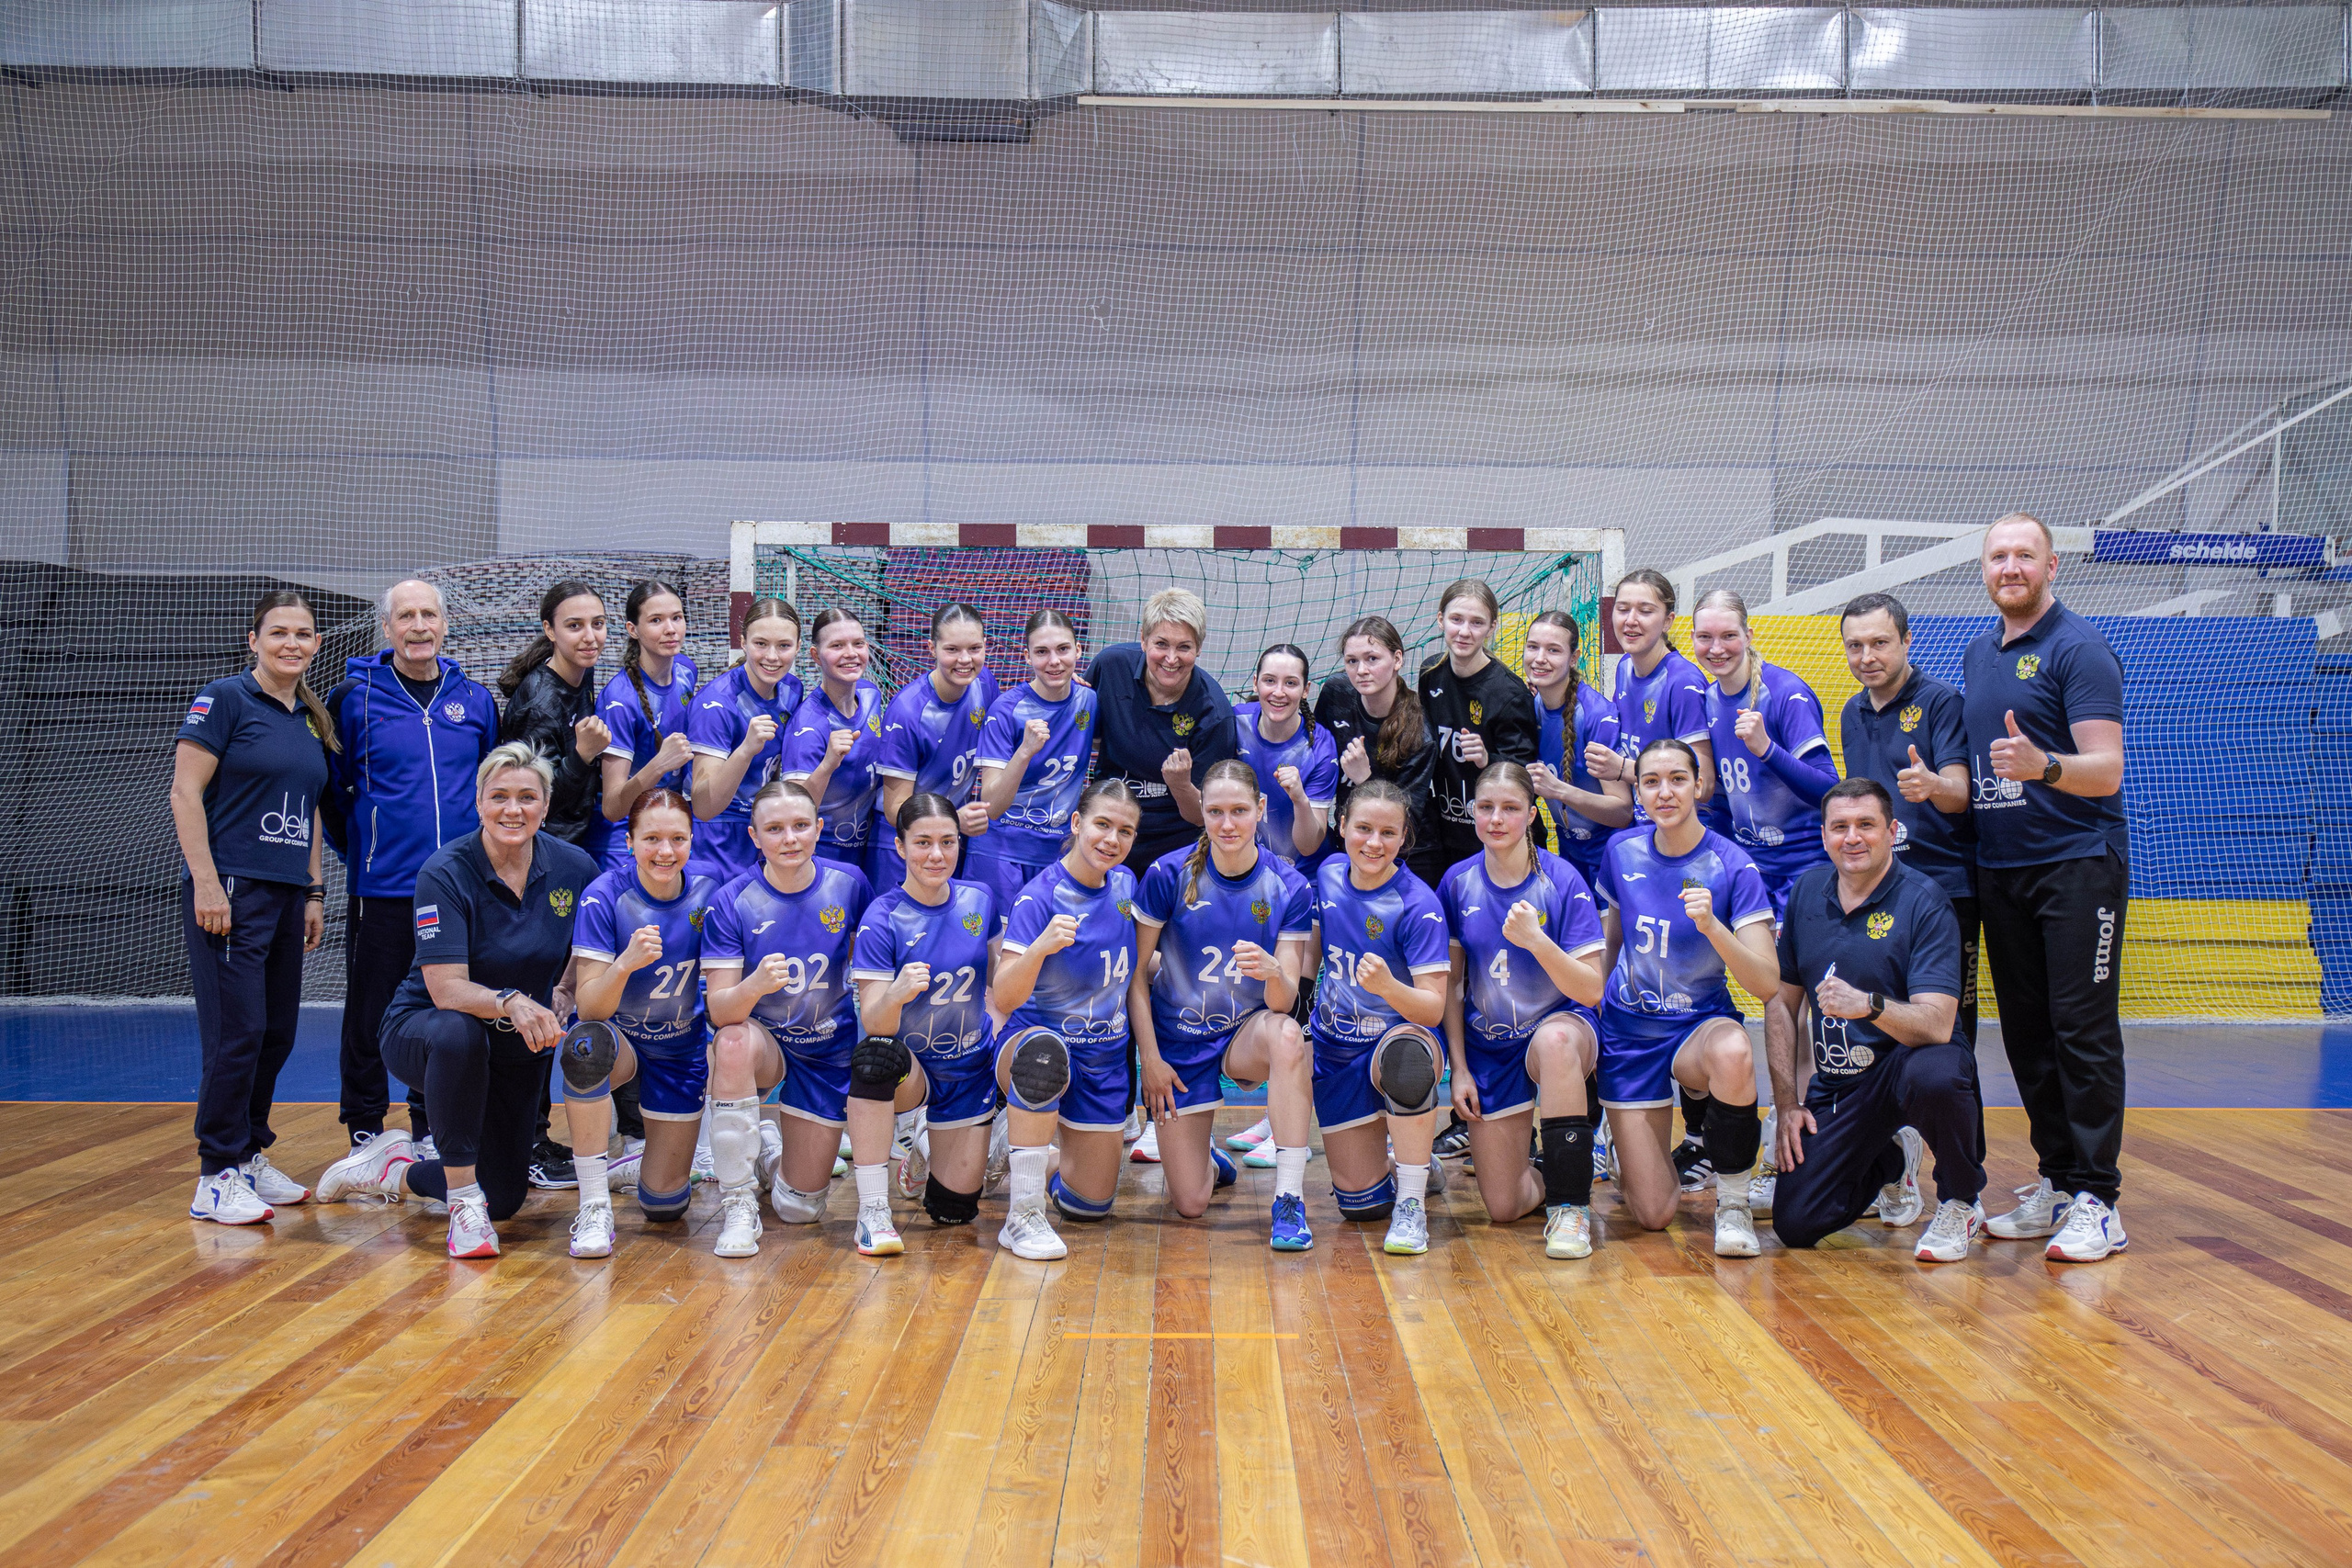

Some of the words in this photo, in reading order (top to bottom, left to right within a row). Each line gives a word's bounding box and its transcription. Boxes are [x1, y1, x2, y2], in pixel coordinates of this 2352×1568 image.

[2169, 540, 2257, 560] schelde
[1438, 726, 1466, 763] 76
[1038, 755, 1079, 786] 23
[1720, 757, 1751, 794] 88
[1992, 798, 2028, 809] COMPANIES
[259, 834, 284, 844] GROUP
[284, 837, 291, 845] OF
[1000, 818, 1024, 827] GROUP
[1892, 843, 1911, 852] ANIES
[421, 932, 435, 941] TEAM
[1634, 914, 1671, 959] 51
[2093, 907, 2115, 984] Joma
[649, 958, 696, 999] 27
[784, 953, 830, 995] 92
[1100, 946, 1130, 987] 14
[1198, 945, 1245, 985] 24
[1328, 943, 1357, 987] 31
[1488, 948, 1510, 987] 4
[930, 965, 976, 1006] 22
[653, 1025, 692, 1041] COMPANIES
[782, 1034, 794, 1043] OF
[794, 1032, 835, 1044] COMPANIES
[1177, 1022, 1203, 1036] GROUP
